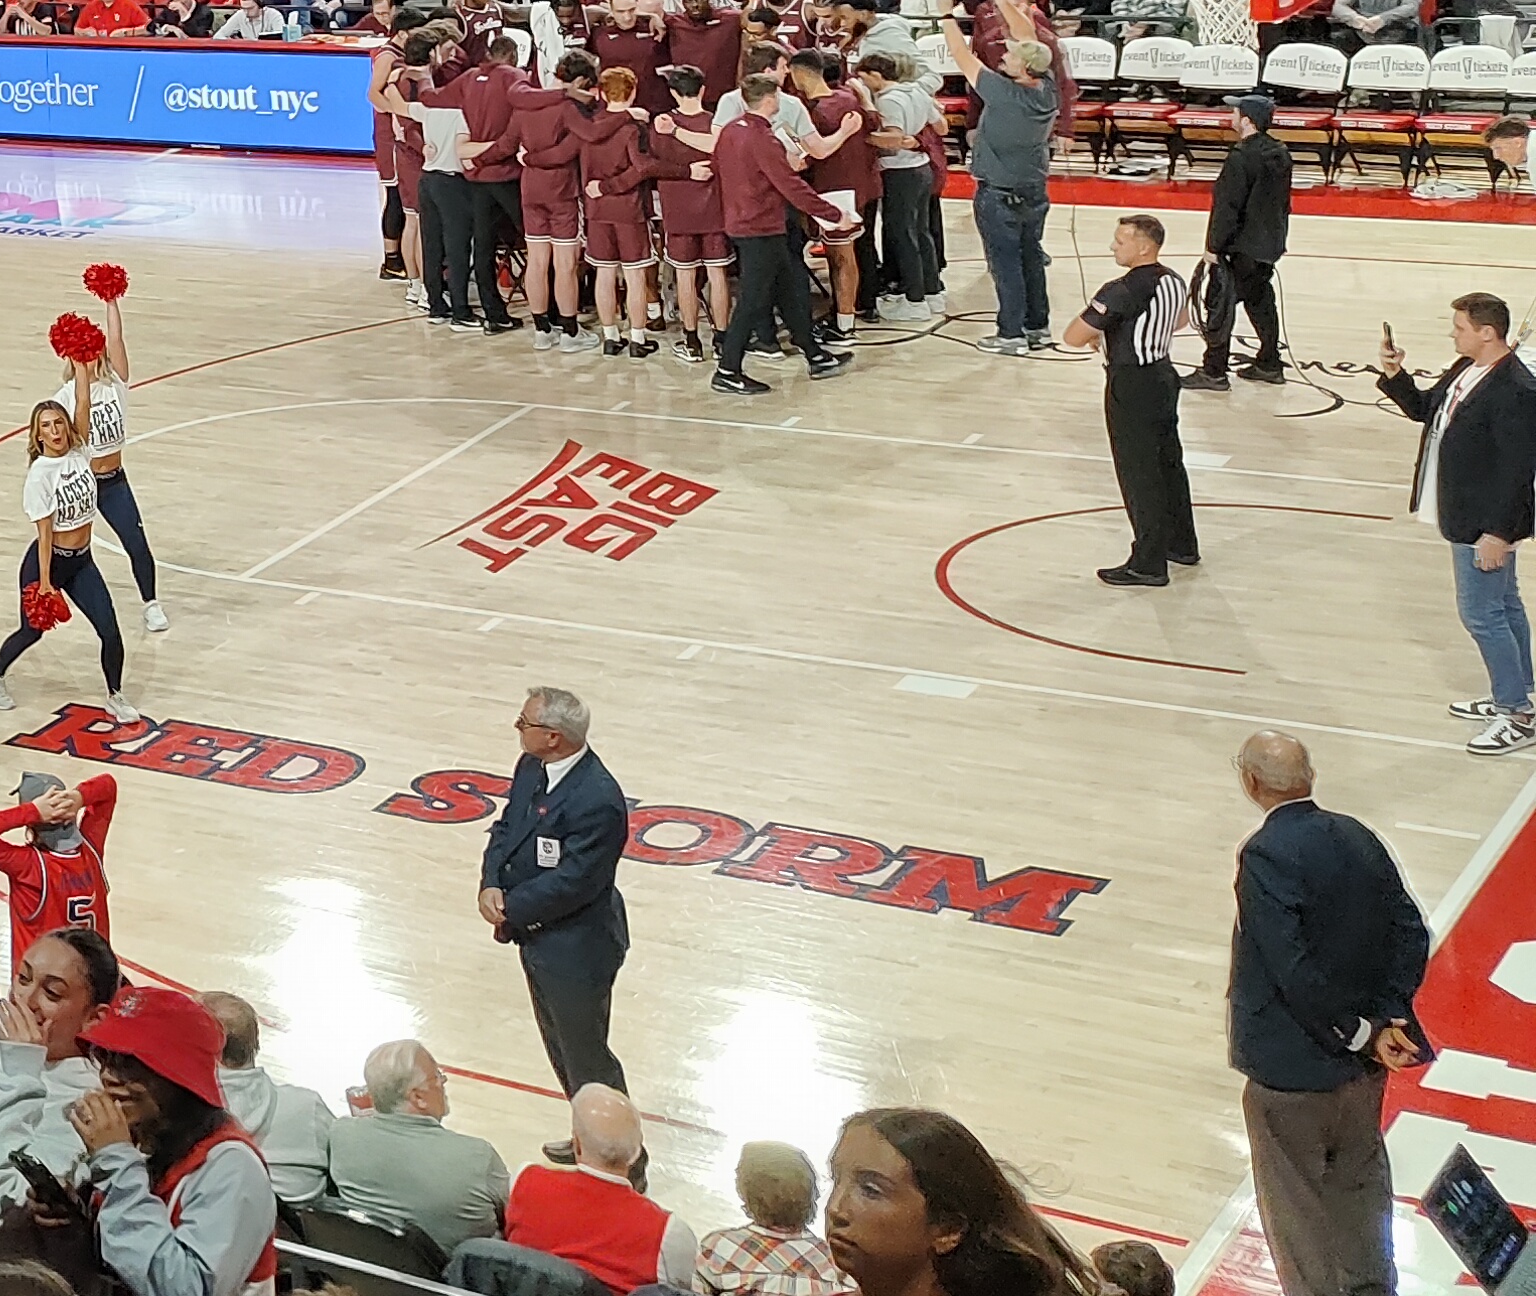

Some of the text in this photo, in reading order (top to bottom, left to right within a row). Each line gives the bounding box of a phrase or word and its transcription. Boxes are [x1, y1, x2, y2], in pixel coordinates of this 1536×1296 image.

[1183, 58, 1254, 71] event tickets
[1270, 58, 1342, 75] event tickets
[164, 83, 320, 120] @stout_nyc
[457, 452, 653, 573] EAST
[562, 471, 721, 562] BIG
[4, 702, 1111, 936] RED SORM
